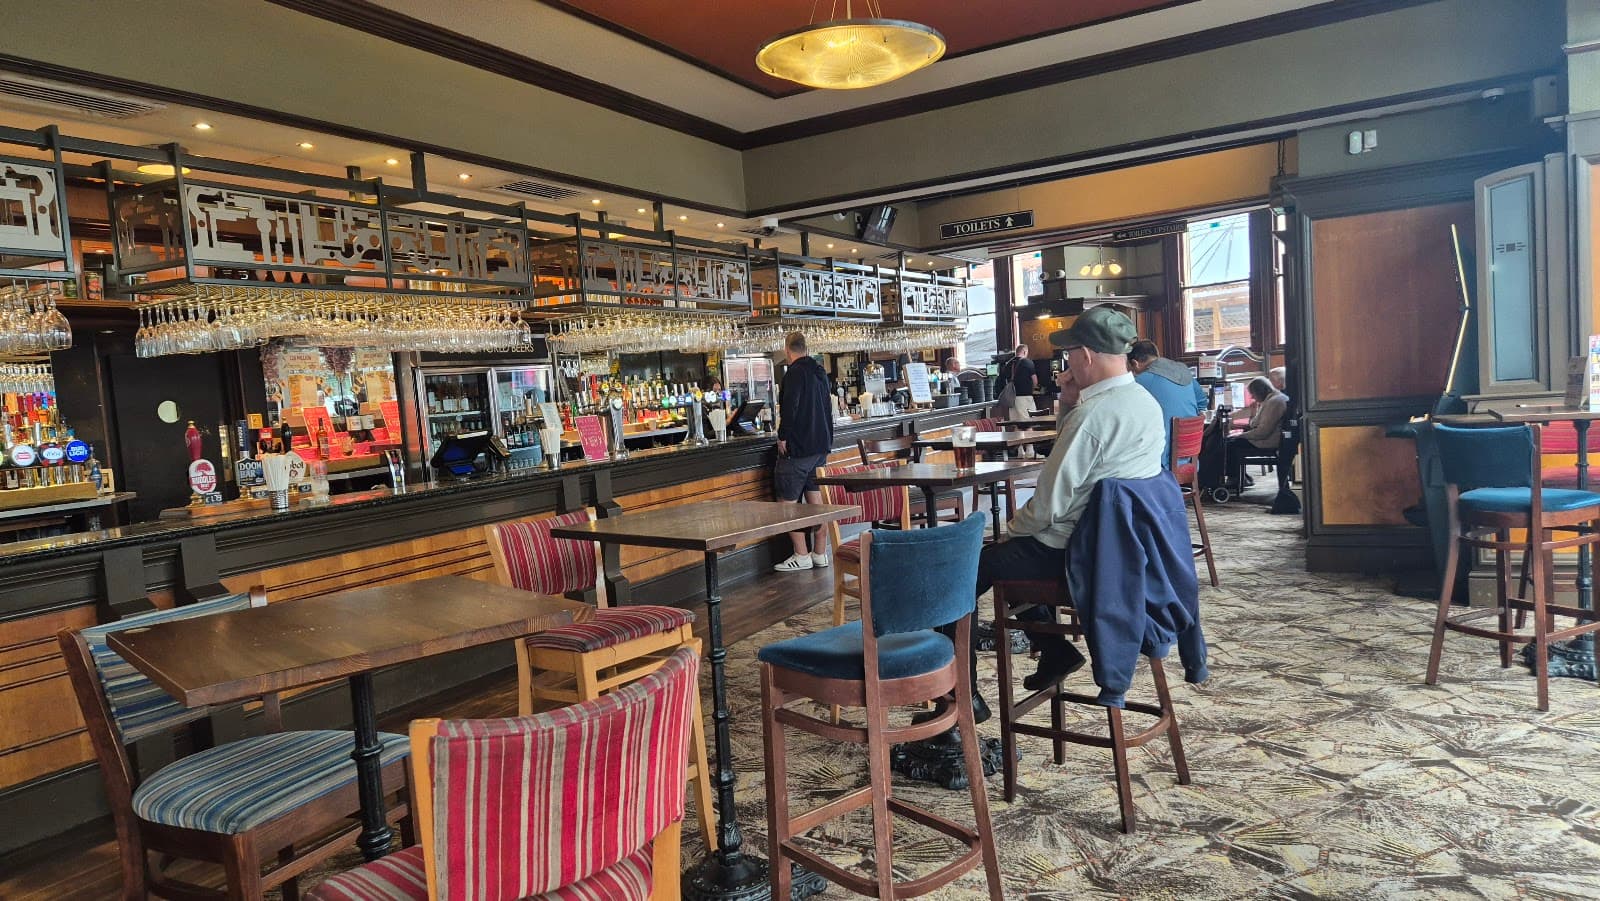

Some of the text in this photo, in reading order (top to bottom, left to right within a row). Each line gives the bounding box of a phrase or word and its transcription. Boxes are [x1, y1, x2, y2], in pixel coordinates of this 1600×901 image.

[954, 219, 1001, 234] TOILETS
[1128, 223, 1184, 238] TOILETS UPSTAIRS
[240, 470, 256, 479] BAR
